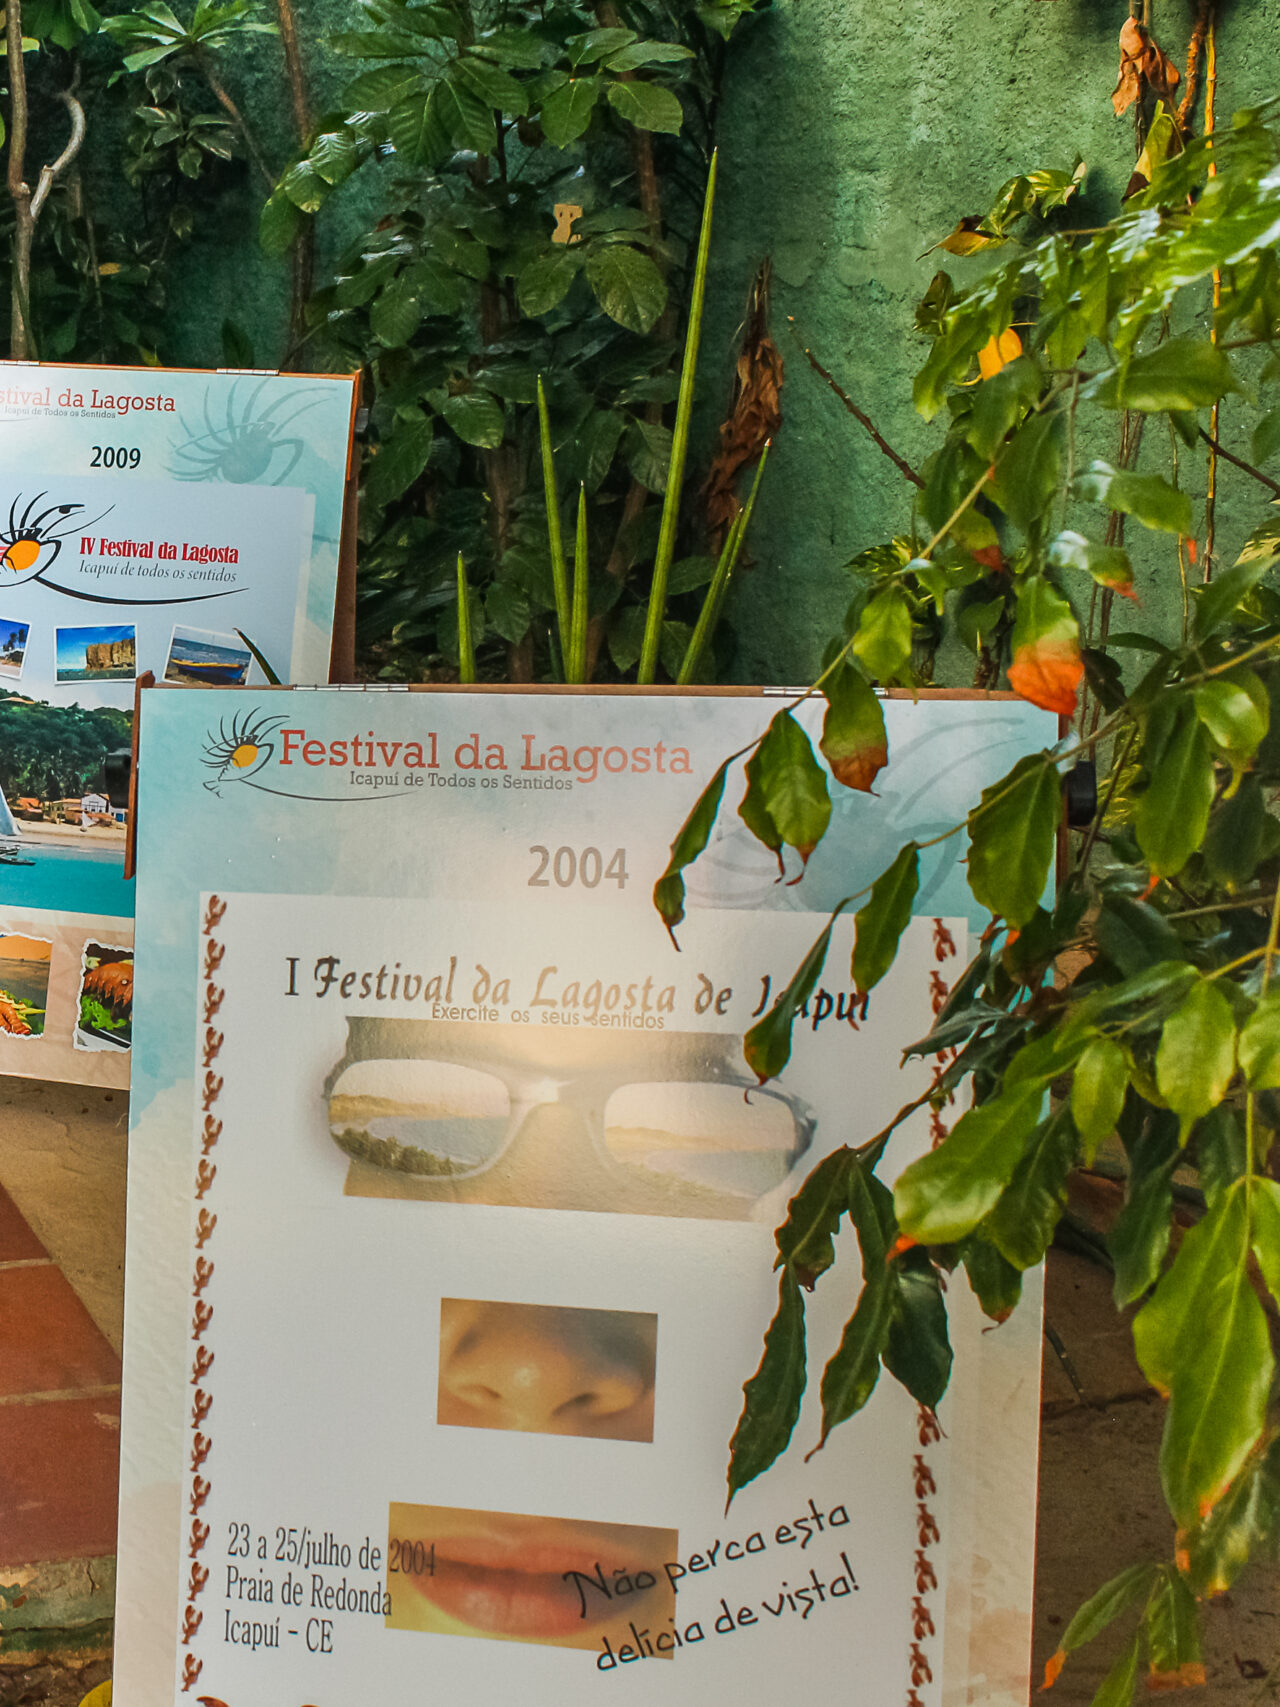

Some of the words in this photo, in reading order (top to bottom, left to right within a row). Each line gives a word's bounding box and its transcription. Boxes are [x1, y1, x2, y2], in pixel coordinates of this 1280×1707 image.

[44, 408, 68, 416] Todos
[81, 410, 116, 419] Sentidos
[58, 389, 84, 408] da
[91, 389, 176, 415] Lagosta
[90, 446, 141, 469] 2009
[79, 560, 120, 579] Icapuí
[121, 561, 135, 576] de
[137, 563, 170, 578] todos
[172, 569, 185, 579] os
[187, 566, 237, 583] sentidos
[80, 537, 96, 555] IV
[99, 538, 154, 559] Festival
[158, 542, 177, 560] da
[181, 543, 239, 565] Lagosta
[279, 729, 440, 769] Festival
[454, 734, 508, 770] da
[521, 734, 694, 783] Lagosta
[349, 771, 399, 789] Icapuí
[403, 773, 425, 787] de
[428, 773, 476, 789] Todos
[481, 777, 499, 789] os
[503, 775, 573, 791] Sentidos
[527, 845, 629, 889] 2004
[284, 957, 300, 996] I
[314, 955, 457, 1004] Festival
[472, 964, 511, 1005] da
[528, 965, 677, 1021] Lagosta
[694, 972, 732, 1016] de
[431, 1001, 500, 1023] Exercite
[510, 1010, 531, 1023] os
[541, 1010, 580, 1026] seus
[590, 1010, 665, 1030] sentidos
[227, 1522, 250, 1557] 23
[257, 1535, 267, 1559] a
[275, 1526, 351, 1568] 25/julho
[358, 1536, 382, 1571] de
[389, 1538, 436, 1577] 2004
[562, 1562, 657, 1619] Não
[663, 1532, 767, 1594] perca
[775, 1499, 850, 1549] esta
[225, 1564, 274, 1604] Praia
[280, 1572, 304, 1607] de
[310, 1573, 393, 1616] Redonda
[596, 1618, 705, 1672] delícia
[714, 1598, 759, 1634] de
[761, 1552, 860, 1619] vista!
[223, 1608, 281, 1651] Icapuí
[305, 1616, 334, 1653] CE
